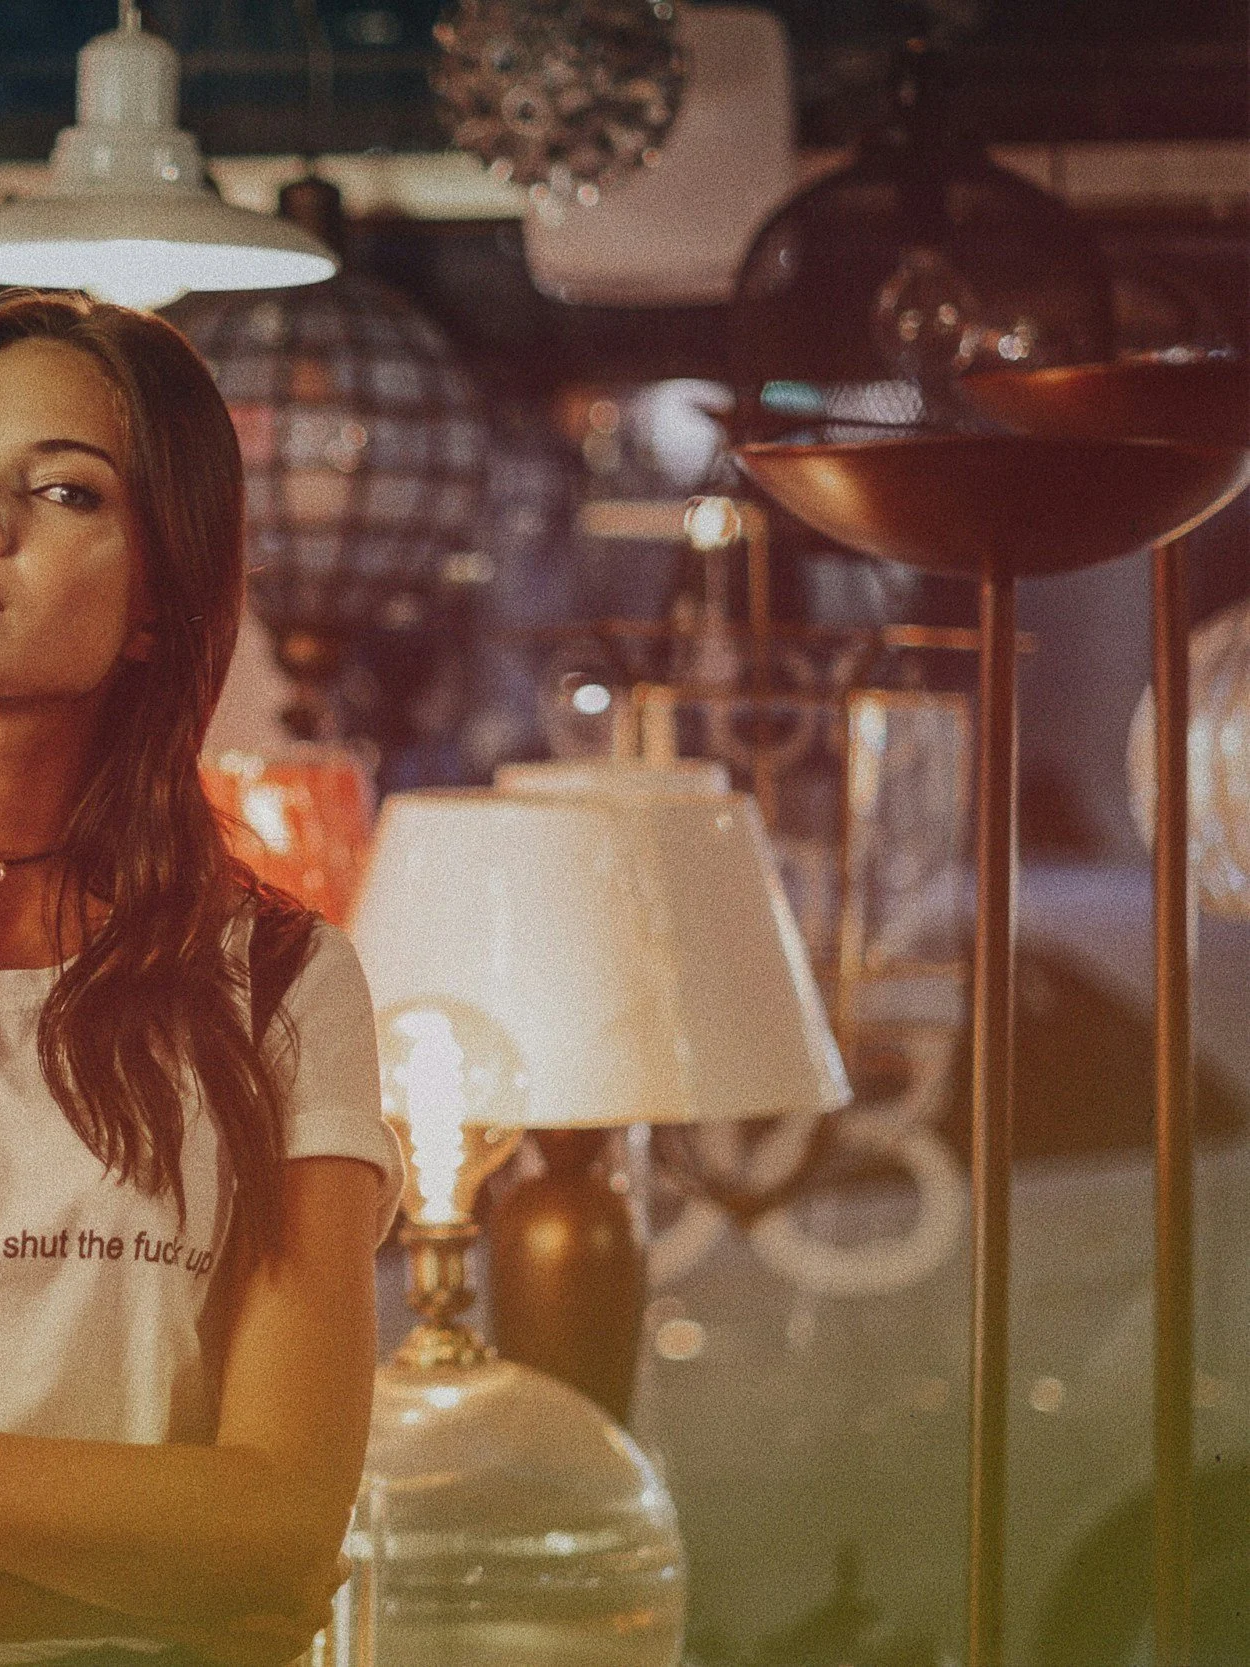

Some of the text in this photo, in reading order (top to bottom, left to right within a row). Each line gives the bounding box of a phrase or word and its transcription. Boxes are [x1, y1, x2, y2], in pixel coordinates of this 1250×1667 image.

[2, 1229, 69, 1259] shut
[78, 1229, 124, 1260] the
[134, 1230, 184, 1266] fuck
[185, 1247, 213, 1280] up
